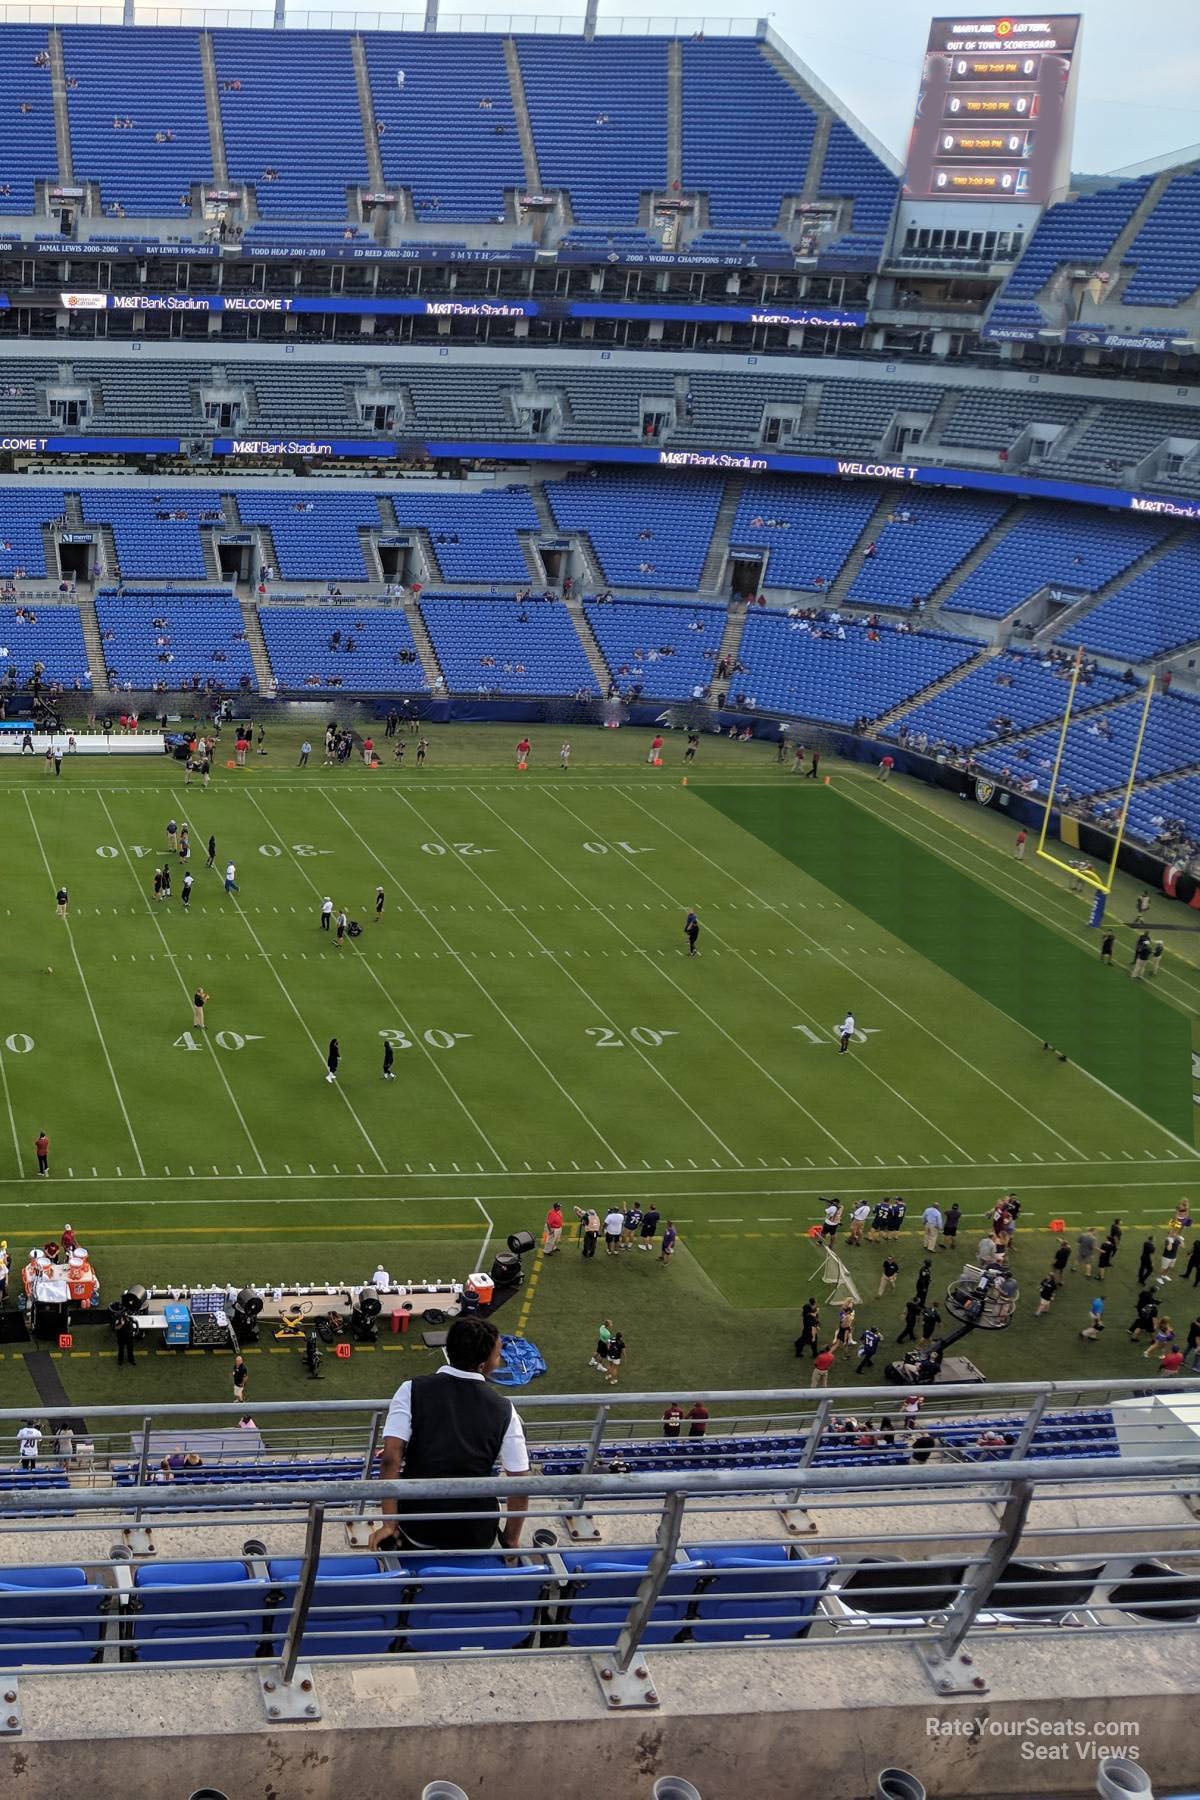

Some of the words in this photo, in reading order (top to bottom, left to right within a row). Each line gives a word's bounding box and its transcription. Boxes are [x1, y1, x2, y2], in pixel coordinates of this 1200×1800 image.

[947, 41, 963, 50] OUT
[965, 41, 977, 50] OF
[978, 41, 1002, 50] TOWN
[1003, 40, 1056, 49] SCOREBOARD
[957, 60, 967, 74] 0
[1023, 59, 1034, 74] 0
[950, 98, 961, 112] 0
[1016, 98, 1026, 112] 0
[943, 135, 954, 149] 0
[1008, 136, 1019, 150] 0
[937, 172, 947, 187] 0
[984, 177, 996, 185] PM
[1001, 174, 1012, 188] 0
[38, 244, 60, 252] JAMAL
[62, 244, 81, 252] LEWIS
[83, 245, 119, 253] 2000-2006
[160, 246, 179, 254] LEWIS
[180, 246, 214, 254] 1996-2012
[271, 248, 289, 256] HEAP
[290, 248, 326, 256] 2001-2010
[354, 249, 364, 257] ED
[365, 249, 382, 257] REED
[383, 250, 419, 258] 2002-2012
[625, 254, 644, 262] 2000
[649, 255, 675, 263] WORLD
[677, 255, 719, 264] CHAMPIONS
[113, 296, 140, 308] M&T
[141, 296, 167, 308] Bank
[167, 296, 209, 309] Stadium
[224, 298, 281, 310] WELCOME
[282, 299, 293, 310] T
[426, 303, 454, 315] M&T
[455, 303, 481, 315] Bank
[481, 304, 523, 316] Stadium
[990, 330, 1035, 340] RAVENS
[1104, 334, 1167, 351] #RavensFlock
[39, 439, 48, 450] T
[232, 441, 261, 453] M&T
[261, 441, 288, 453] Bank
[288, 442, 332, 455] Stadium
[659, 451, 690, 464] M&T
[690, 453, 719, 465] Bank
[719, 454, 767, 468] Stadium
[837, 462, 905, 478] WELCOME
[906, 467, 918, 479] T
[378, 1029, 455, 1049] 30
[585, 1027, 663, 1047] 20
[792, 1024, 868, 1044] 10
[172, 1031, 245, 1051] 40
[61, 1336, 71, 1346] 50
[339, 1345, 349, 1357] 40
[23, 1438, 36, 1448] 20
